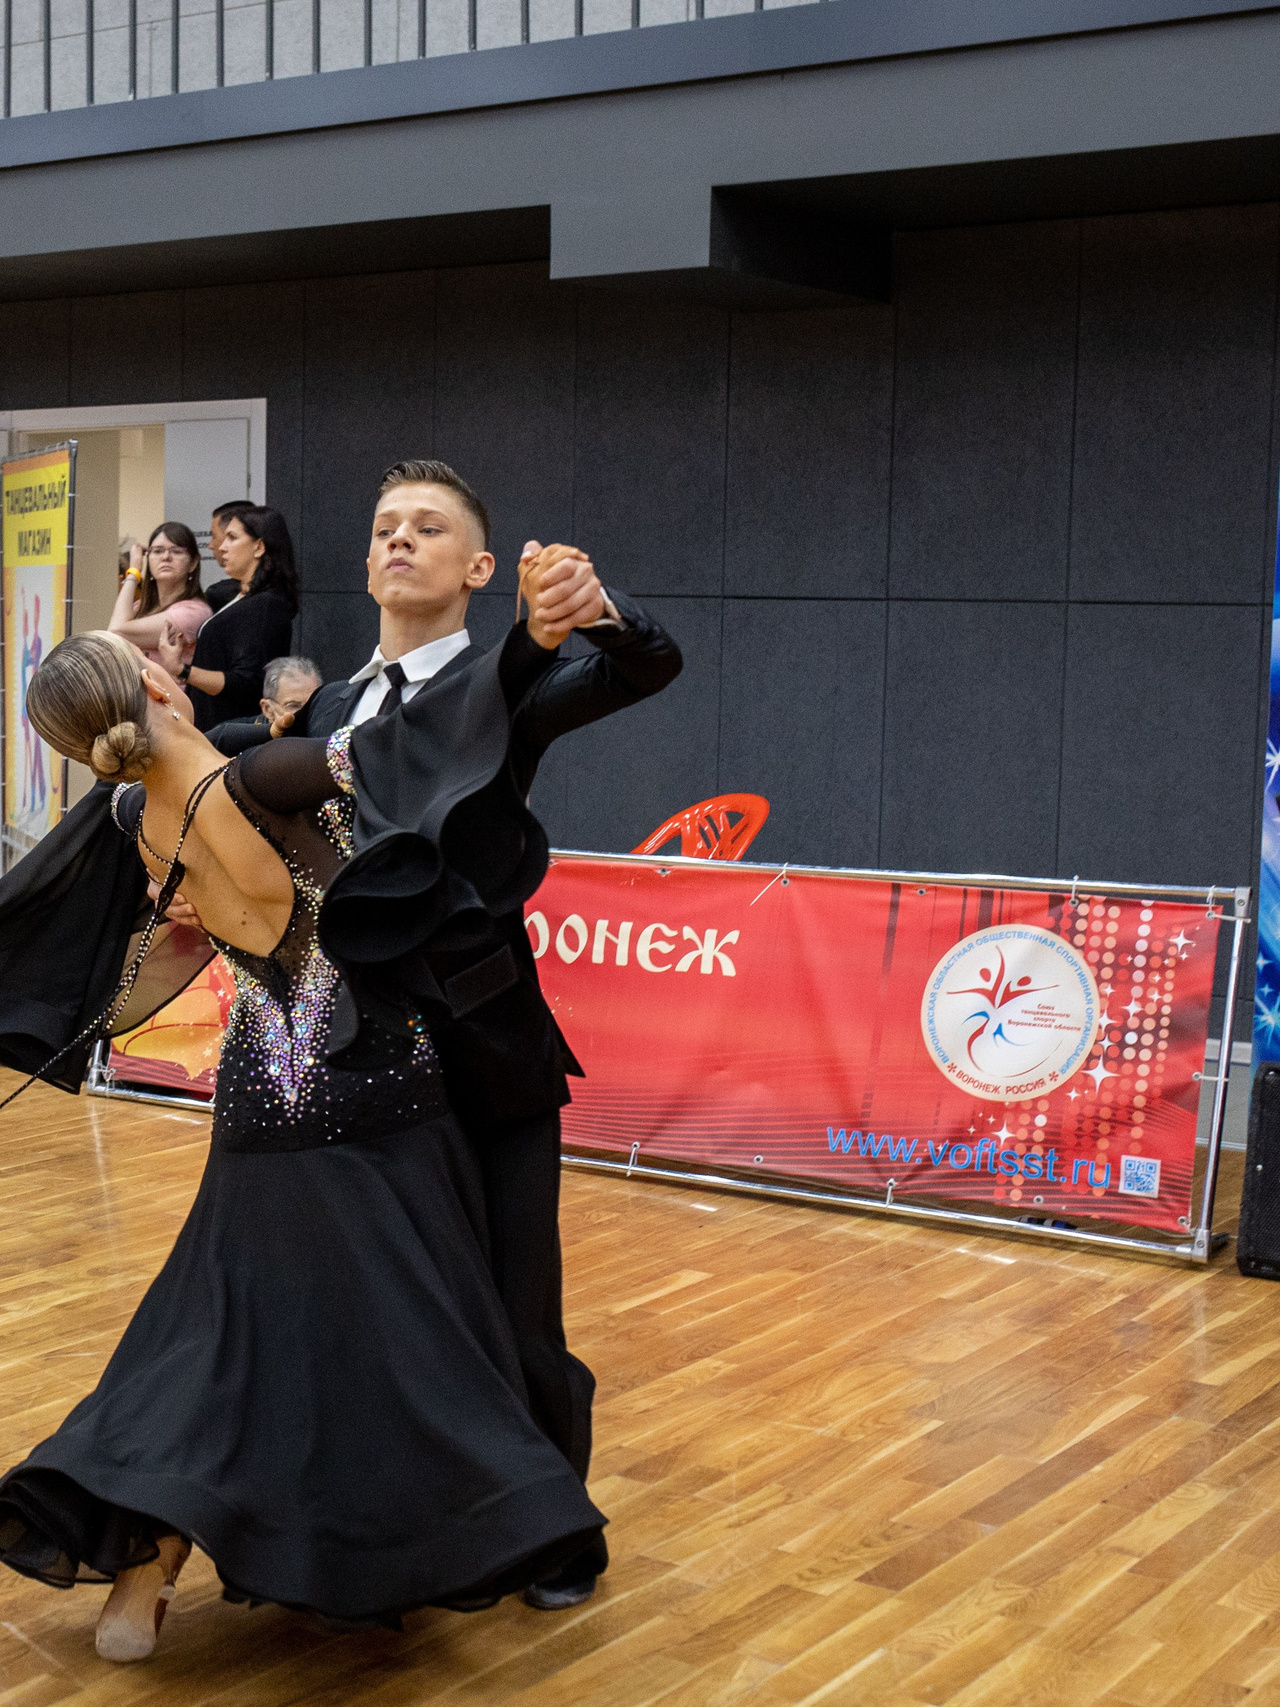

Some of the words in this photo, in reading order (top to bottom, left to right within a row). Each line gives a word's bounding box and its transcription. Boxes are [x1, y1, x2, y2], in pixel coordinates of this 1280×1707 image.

[5, 474, 66, 519] ТАНЦЕВАЛЬНЫЙ
[18, 528, 51, 557] МАГАЗИН
[933, 940, 974, 990] ОБЛАСТНАЯ
[975, 930, 1056, 949] ОБЩЕСТВЕННАЯ
[956, 1070, 1001, 1094] ВОРОНЕЖ
[1005, 1078, 1046, 1095] РОССИЯ
[827, 1127, 1111, 1188] www.voftsst.ru
